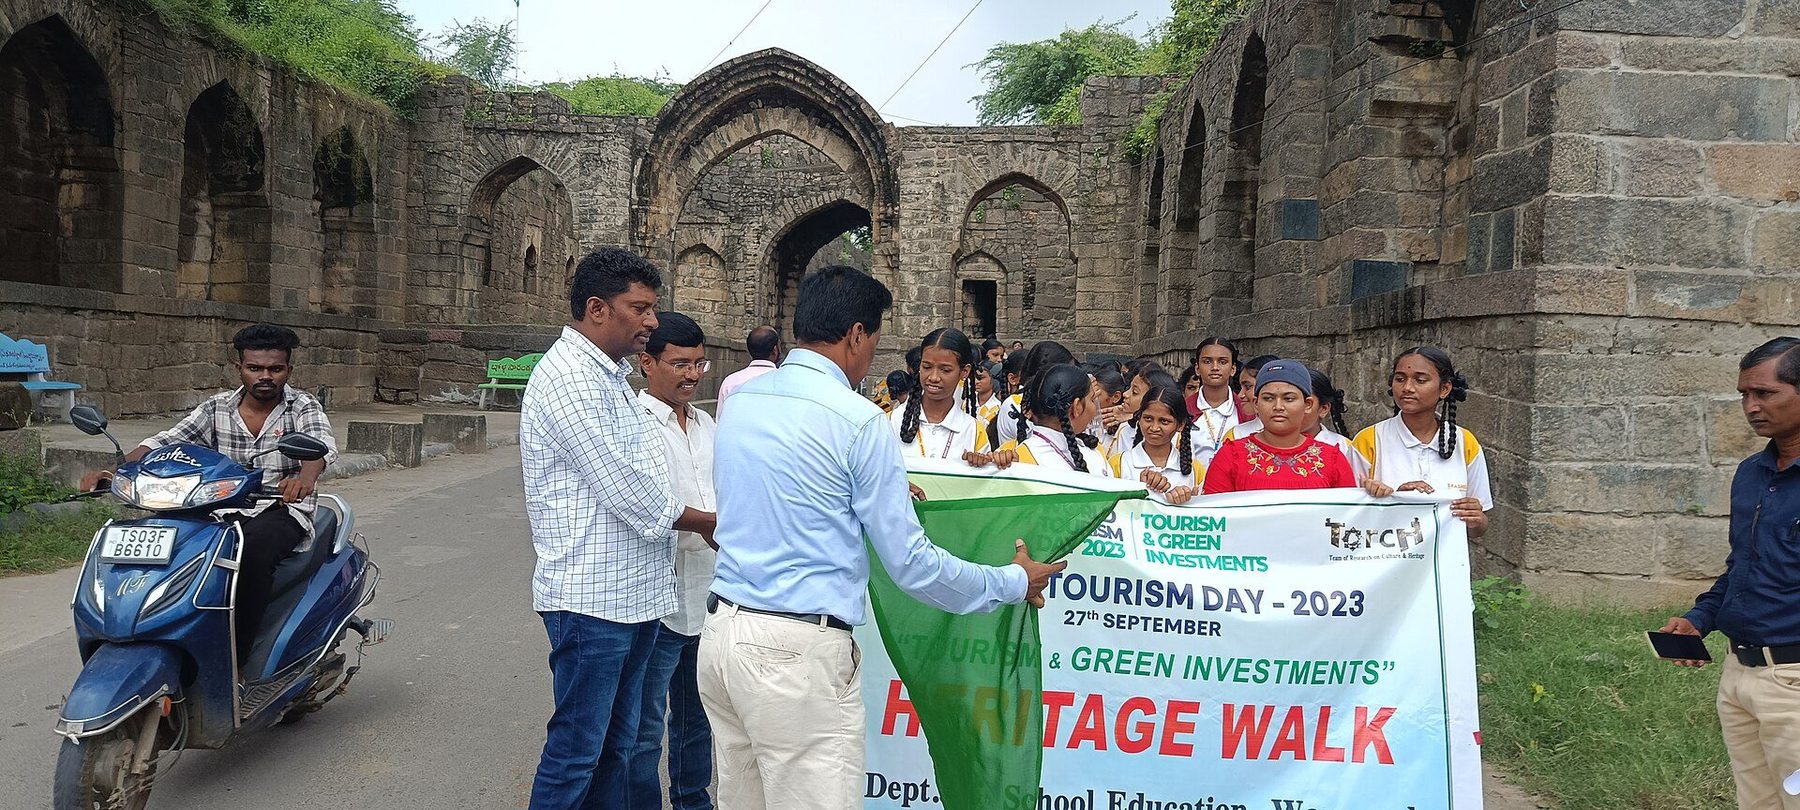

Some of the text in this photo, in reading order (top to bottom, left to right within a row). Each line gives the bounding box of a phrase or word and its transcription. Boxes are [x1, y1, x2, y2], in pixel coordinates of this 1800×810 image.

[1141, 513, 1227, 532] TOURISM
[121, 529, 167, 543] TS03F
[1143, 532, 1221, 550] & GREEN
[113, 544, 161, 557] B6610
[1081, 539, 1126, 559] 2023
[1145, 549, 1269, 573] INVESTMENTS
[1049, 572, 1194, 611] TOURISM
[1201, 584, 1264, 614] DAY
[1291, 589, 1365, 617] 2023
[1103, 612, 1222, 637] SEPTEMBER
[1049, 652, 1061, 669] &
[1071, 646, 1175, 678] GREEN
[1221, 703, 1398, 765] WALK
[864, 772, 940, 807] Dept.
